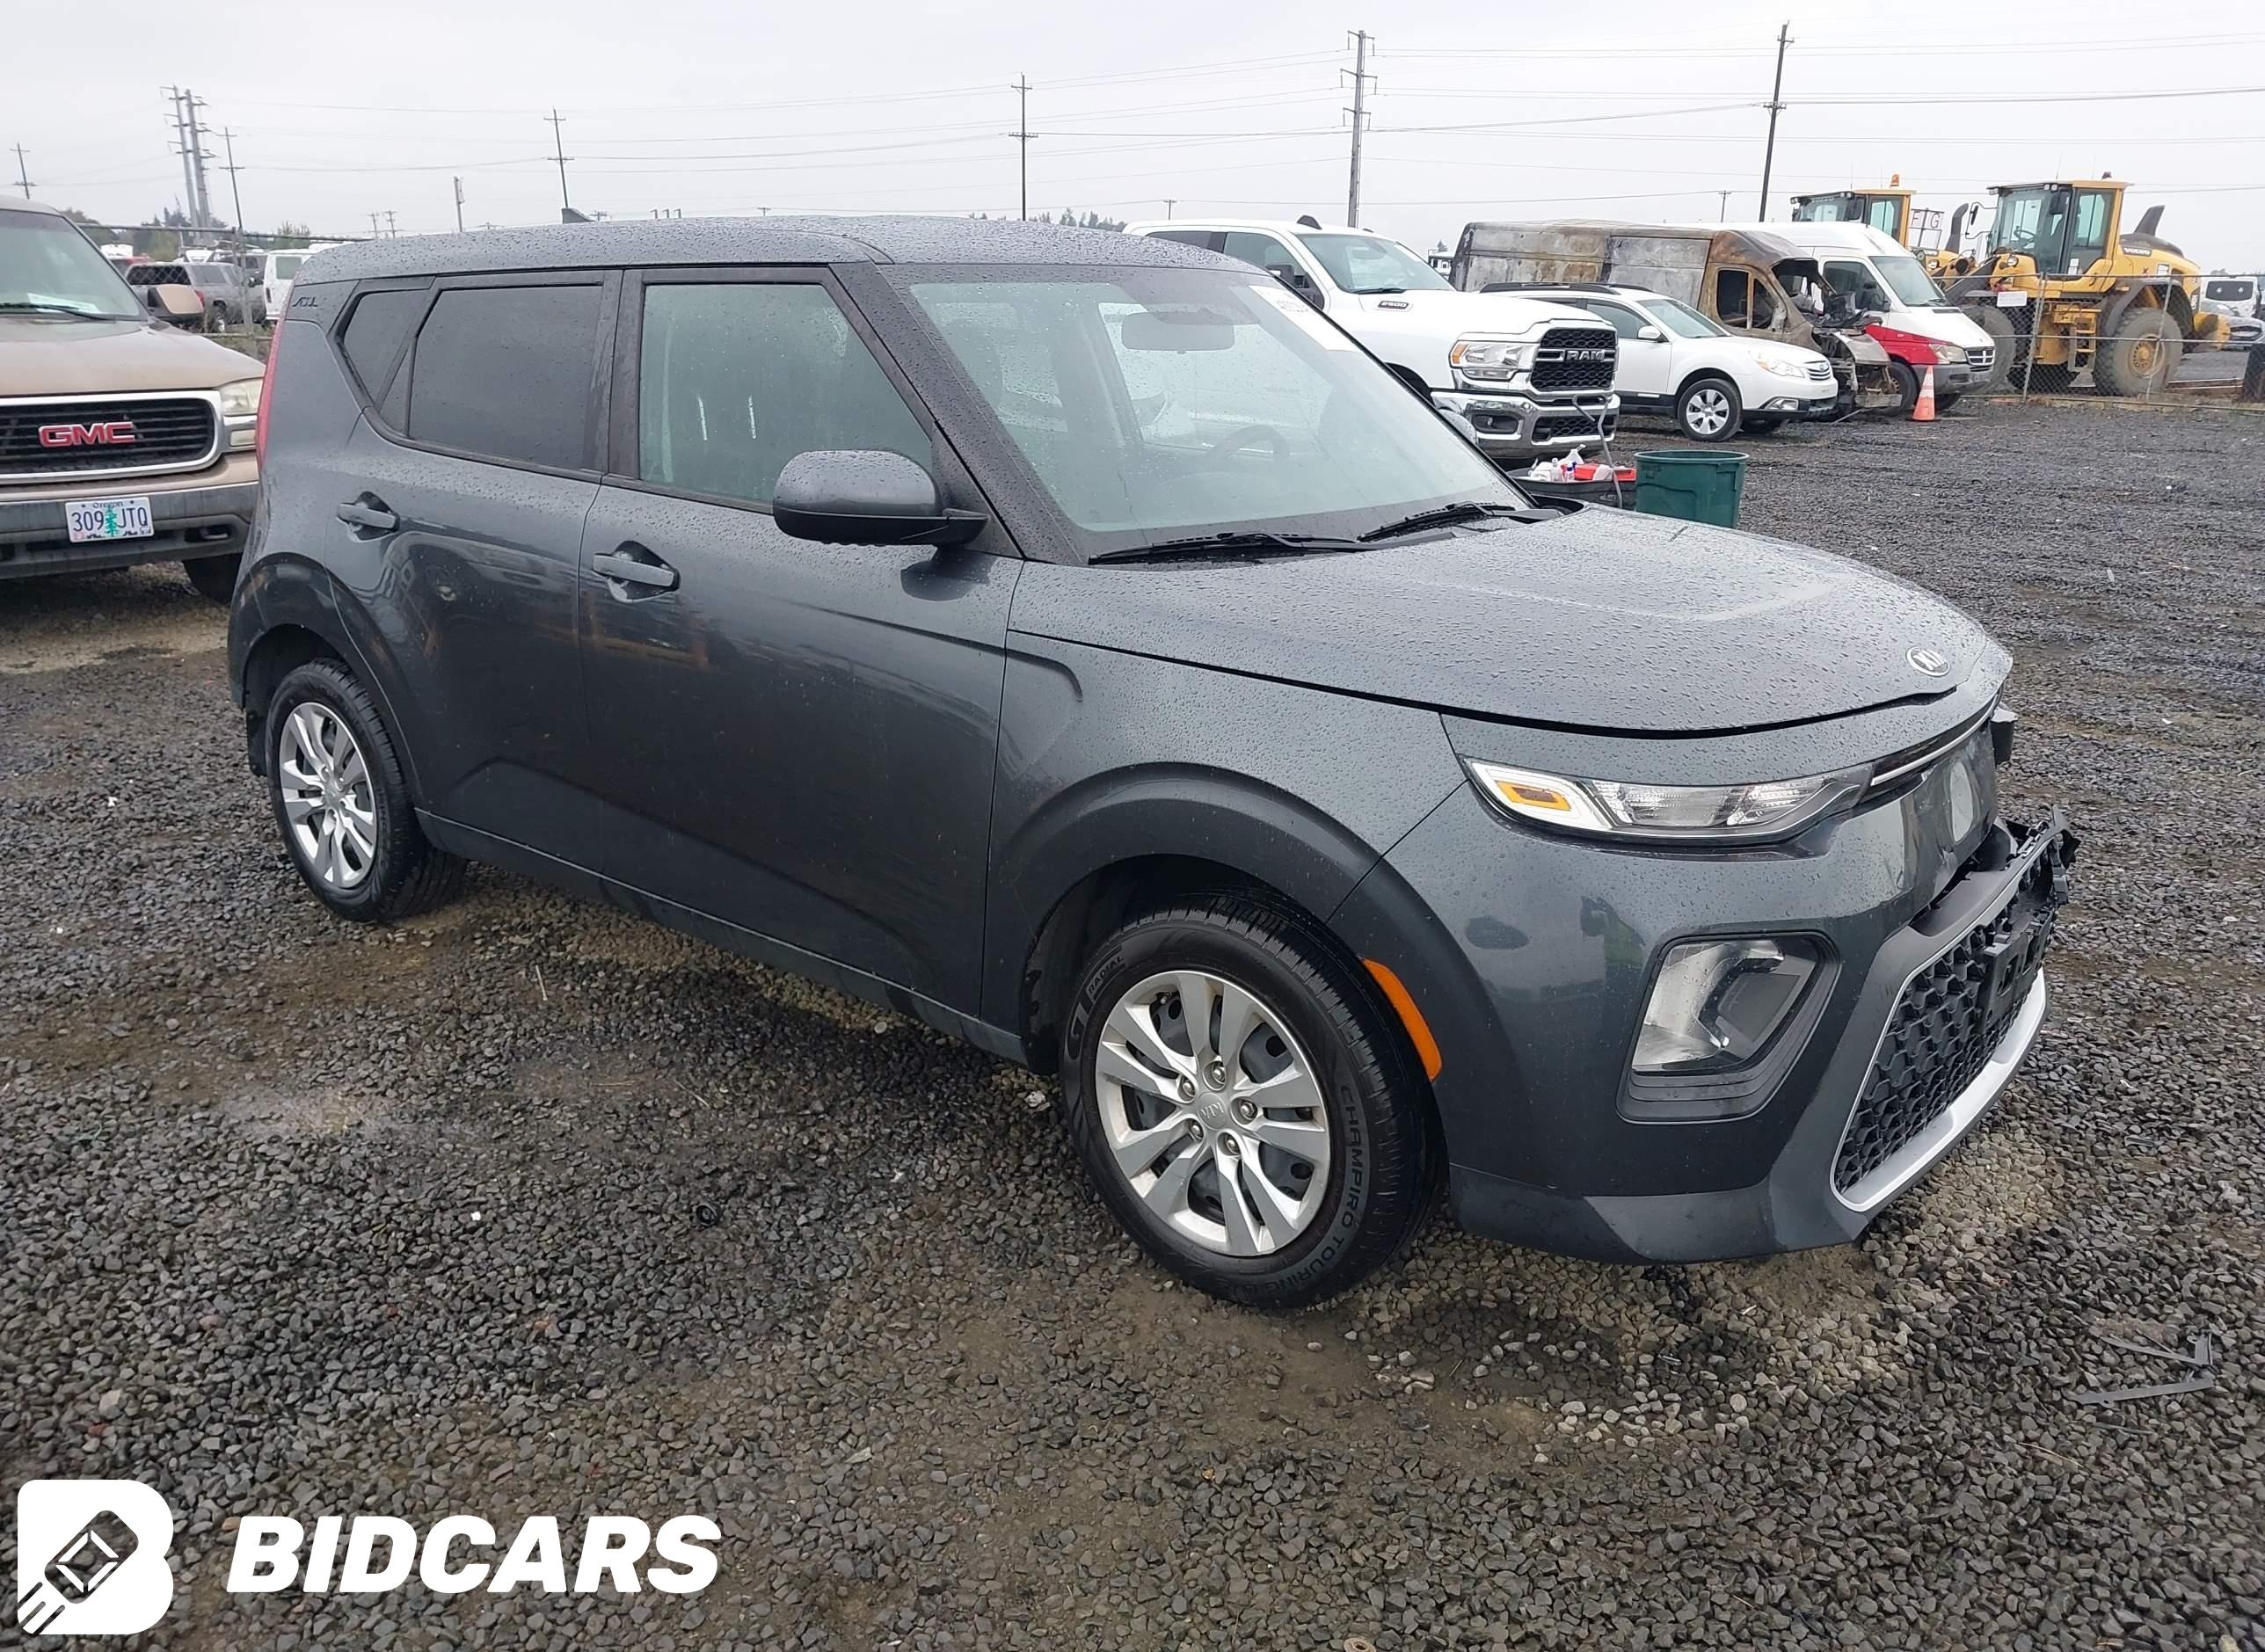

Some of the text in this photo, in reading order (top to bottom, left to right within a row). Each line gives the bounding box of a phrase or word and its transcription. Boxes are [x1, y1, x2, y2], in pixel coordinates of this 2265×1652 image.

[2123, 247, 2151, 256] VOLVO
[1566, 350, 1605, 361] RAM
[38, 421, 136, 448] GMC
[71, 506, 149, 532] 309 JTQ
[1088, 955, 1125, 995] RADIAL
[1339, 1084, 1364, 1229] CHAMPIRO
